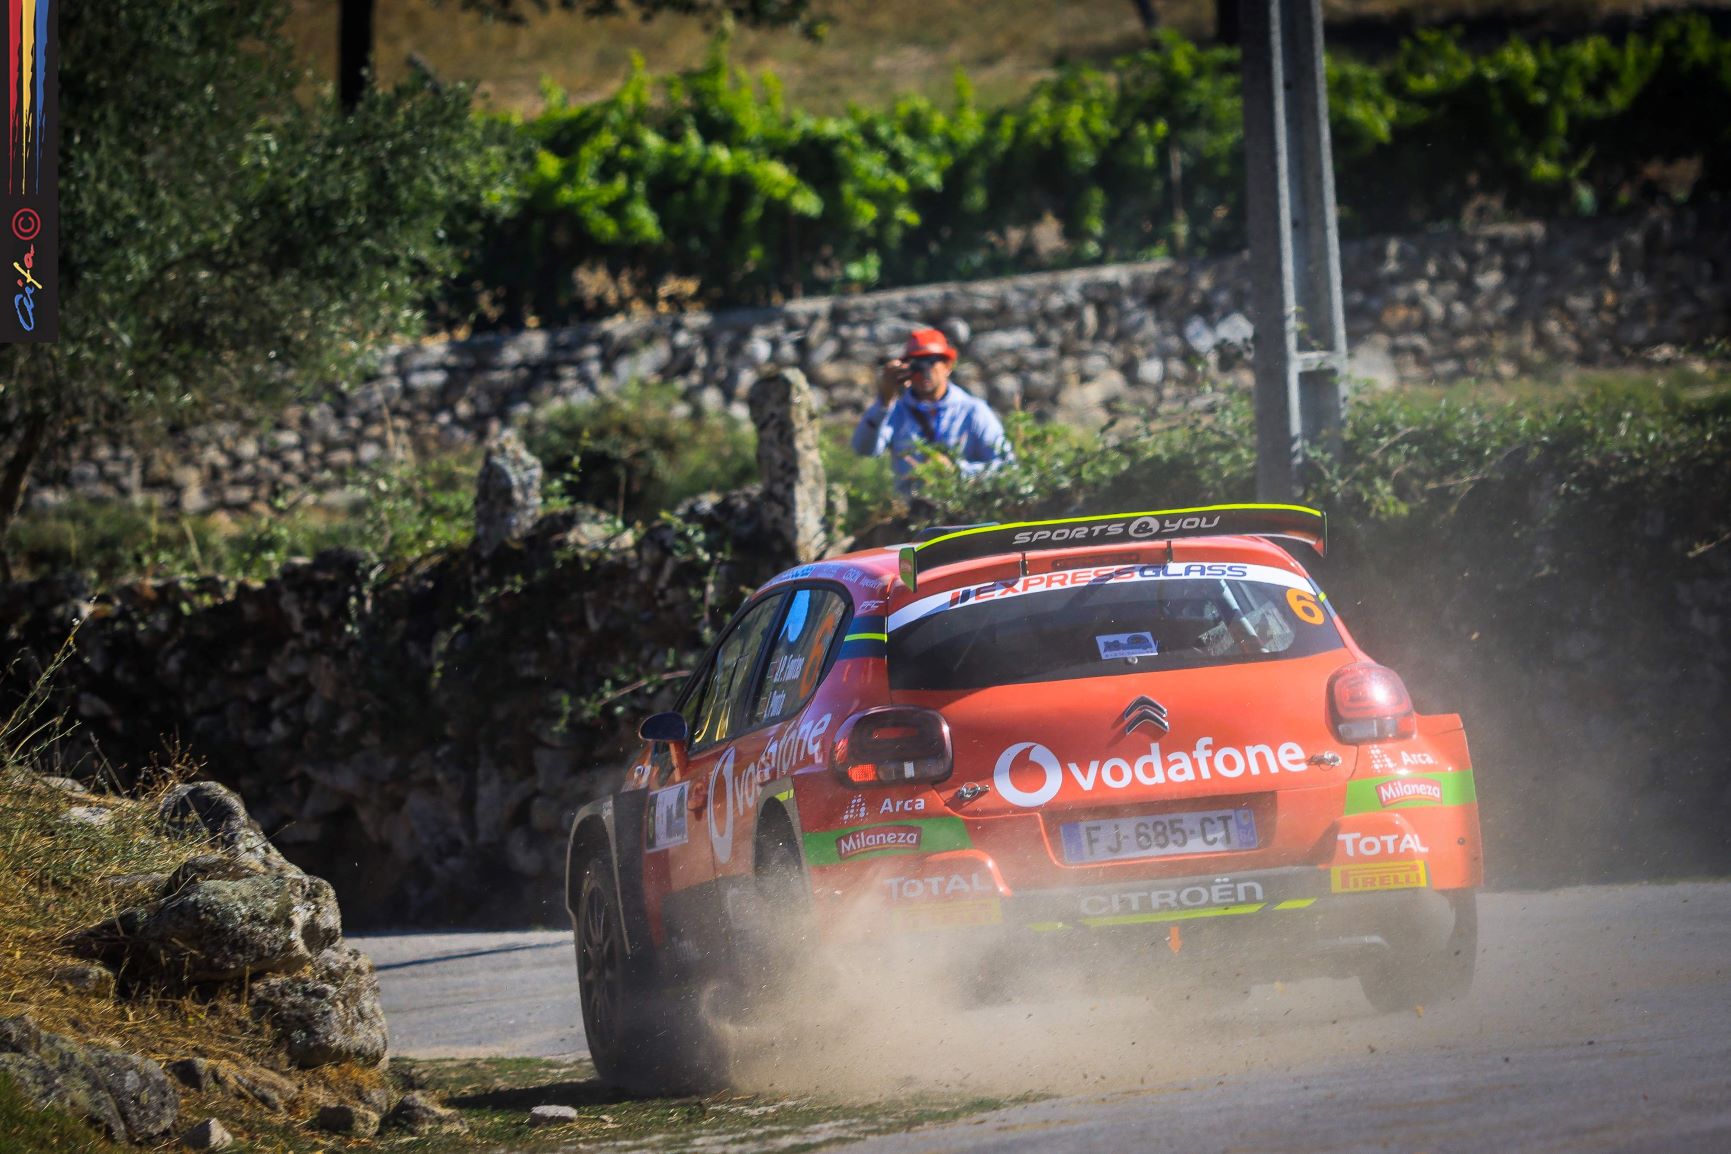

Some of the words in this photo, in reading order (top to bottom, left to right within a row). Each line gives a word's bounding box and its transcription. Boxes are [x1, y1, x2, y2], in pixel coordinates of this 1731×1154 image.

[1012, 522, 1126, 545] SPORTS
[1162, 515, 1221, 532] YOU
[1286, 588, 1325, 625] 6
[1068, 737, 1309, 791] vodafone
[1401, 751, 1434, 766] Arca
[1381, 780, 1440, 801] Milaneza
[880, 798, 925, 814] Arca
[841, 831, 918, 854] Milaneza
[1337, 832, 1429, 857] TOTAL
[885, 872, 993, 900] TOTAL
[1340, 863, 1422, 889] PIRELLI
[1080, 878, 1264, 916] CITROËN
